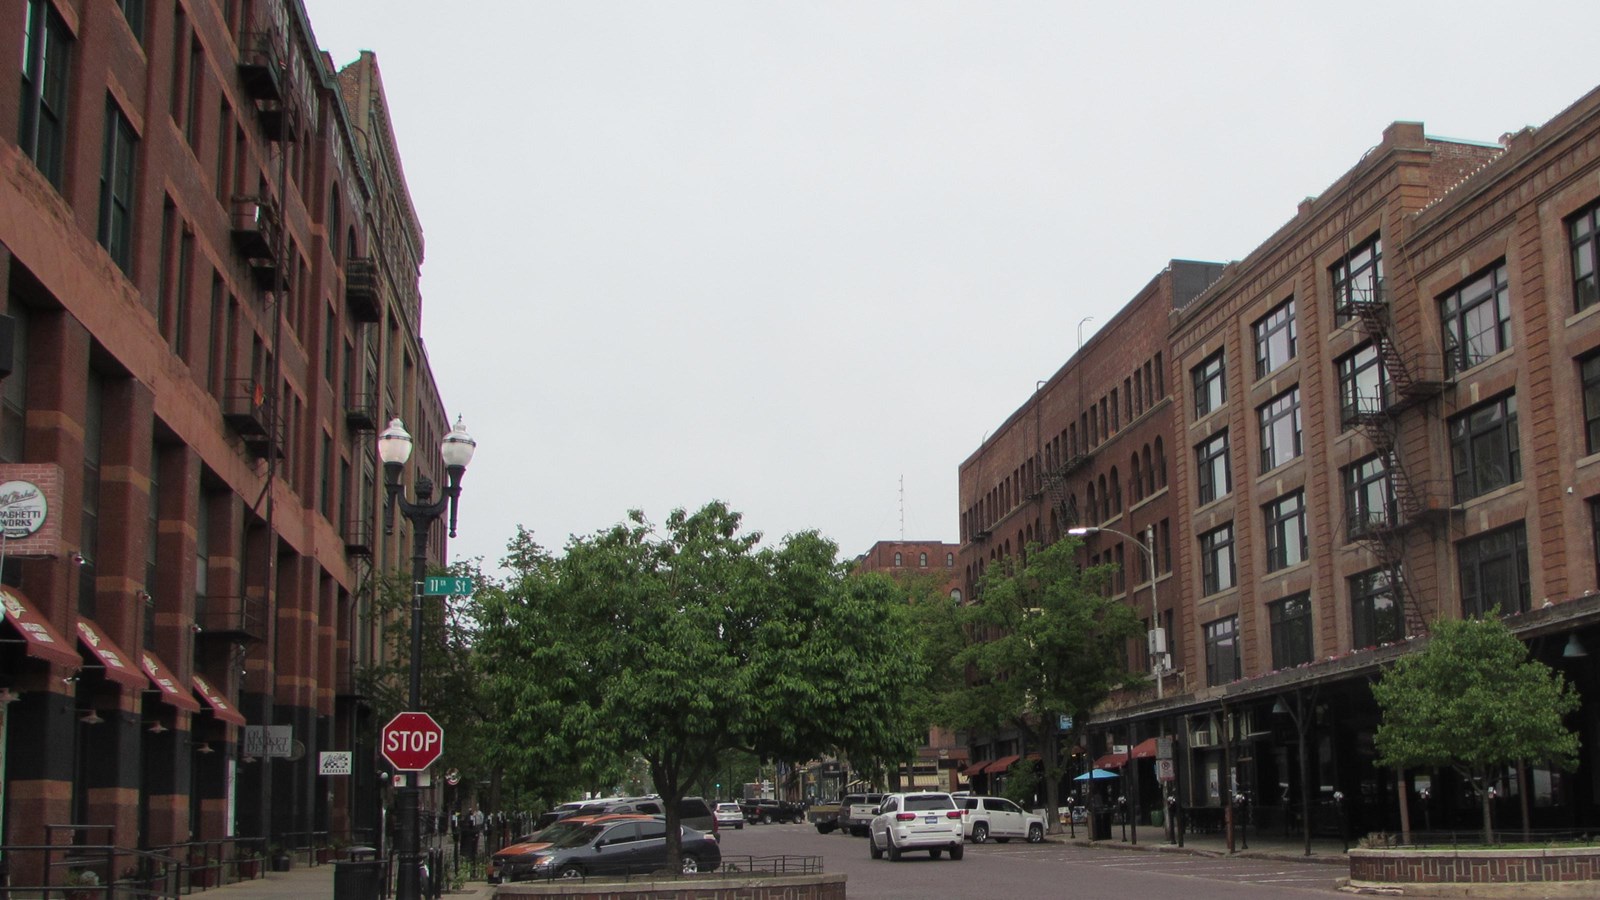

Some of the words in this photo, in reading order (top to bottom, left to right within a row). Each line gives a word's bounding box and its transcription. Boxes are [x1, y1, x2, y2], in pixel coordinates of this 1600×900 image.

[454, 579, 466, 593] St
[247, 736, 289, 745] MAKET
[387, 730, 438, 752] STOP
[247, 744, 289, 752] DETAL
